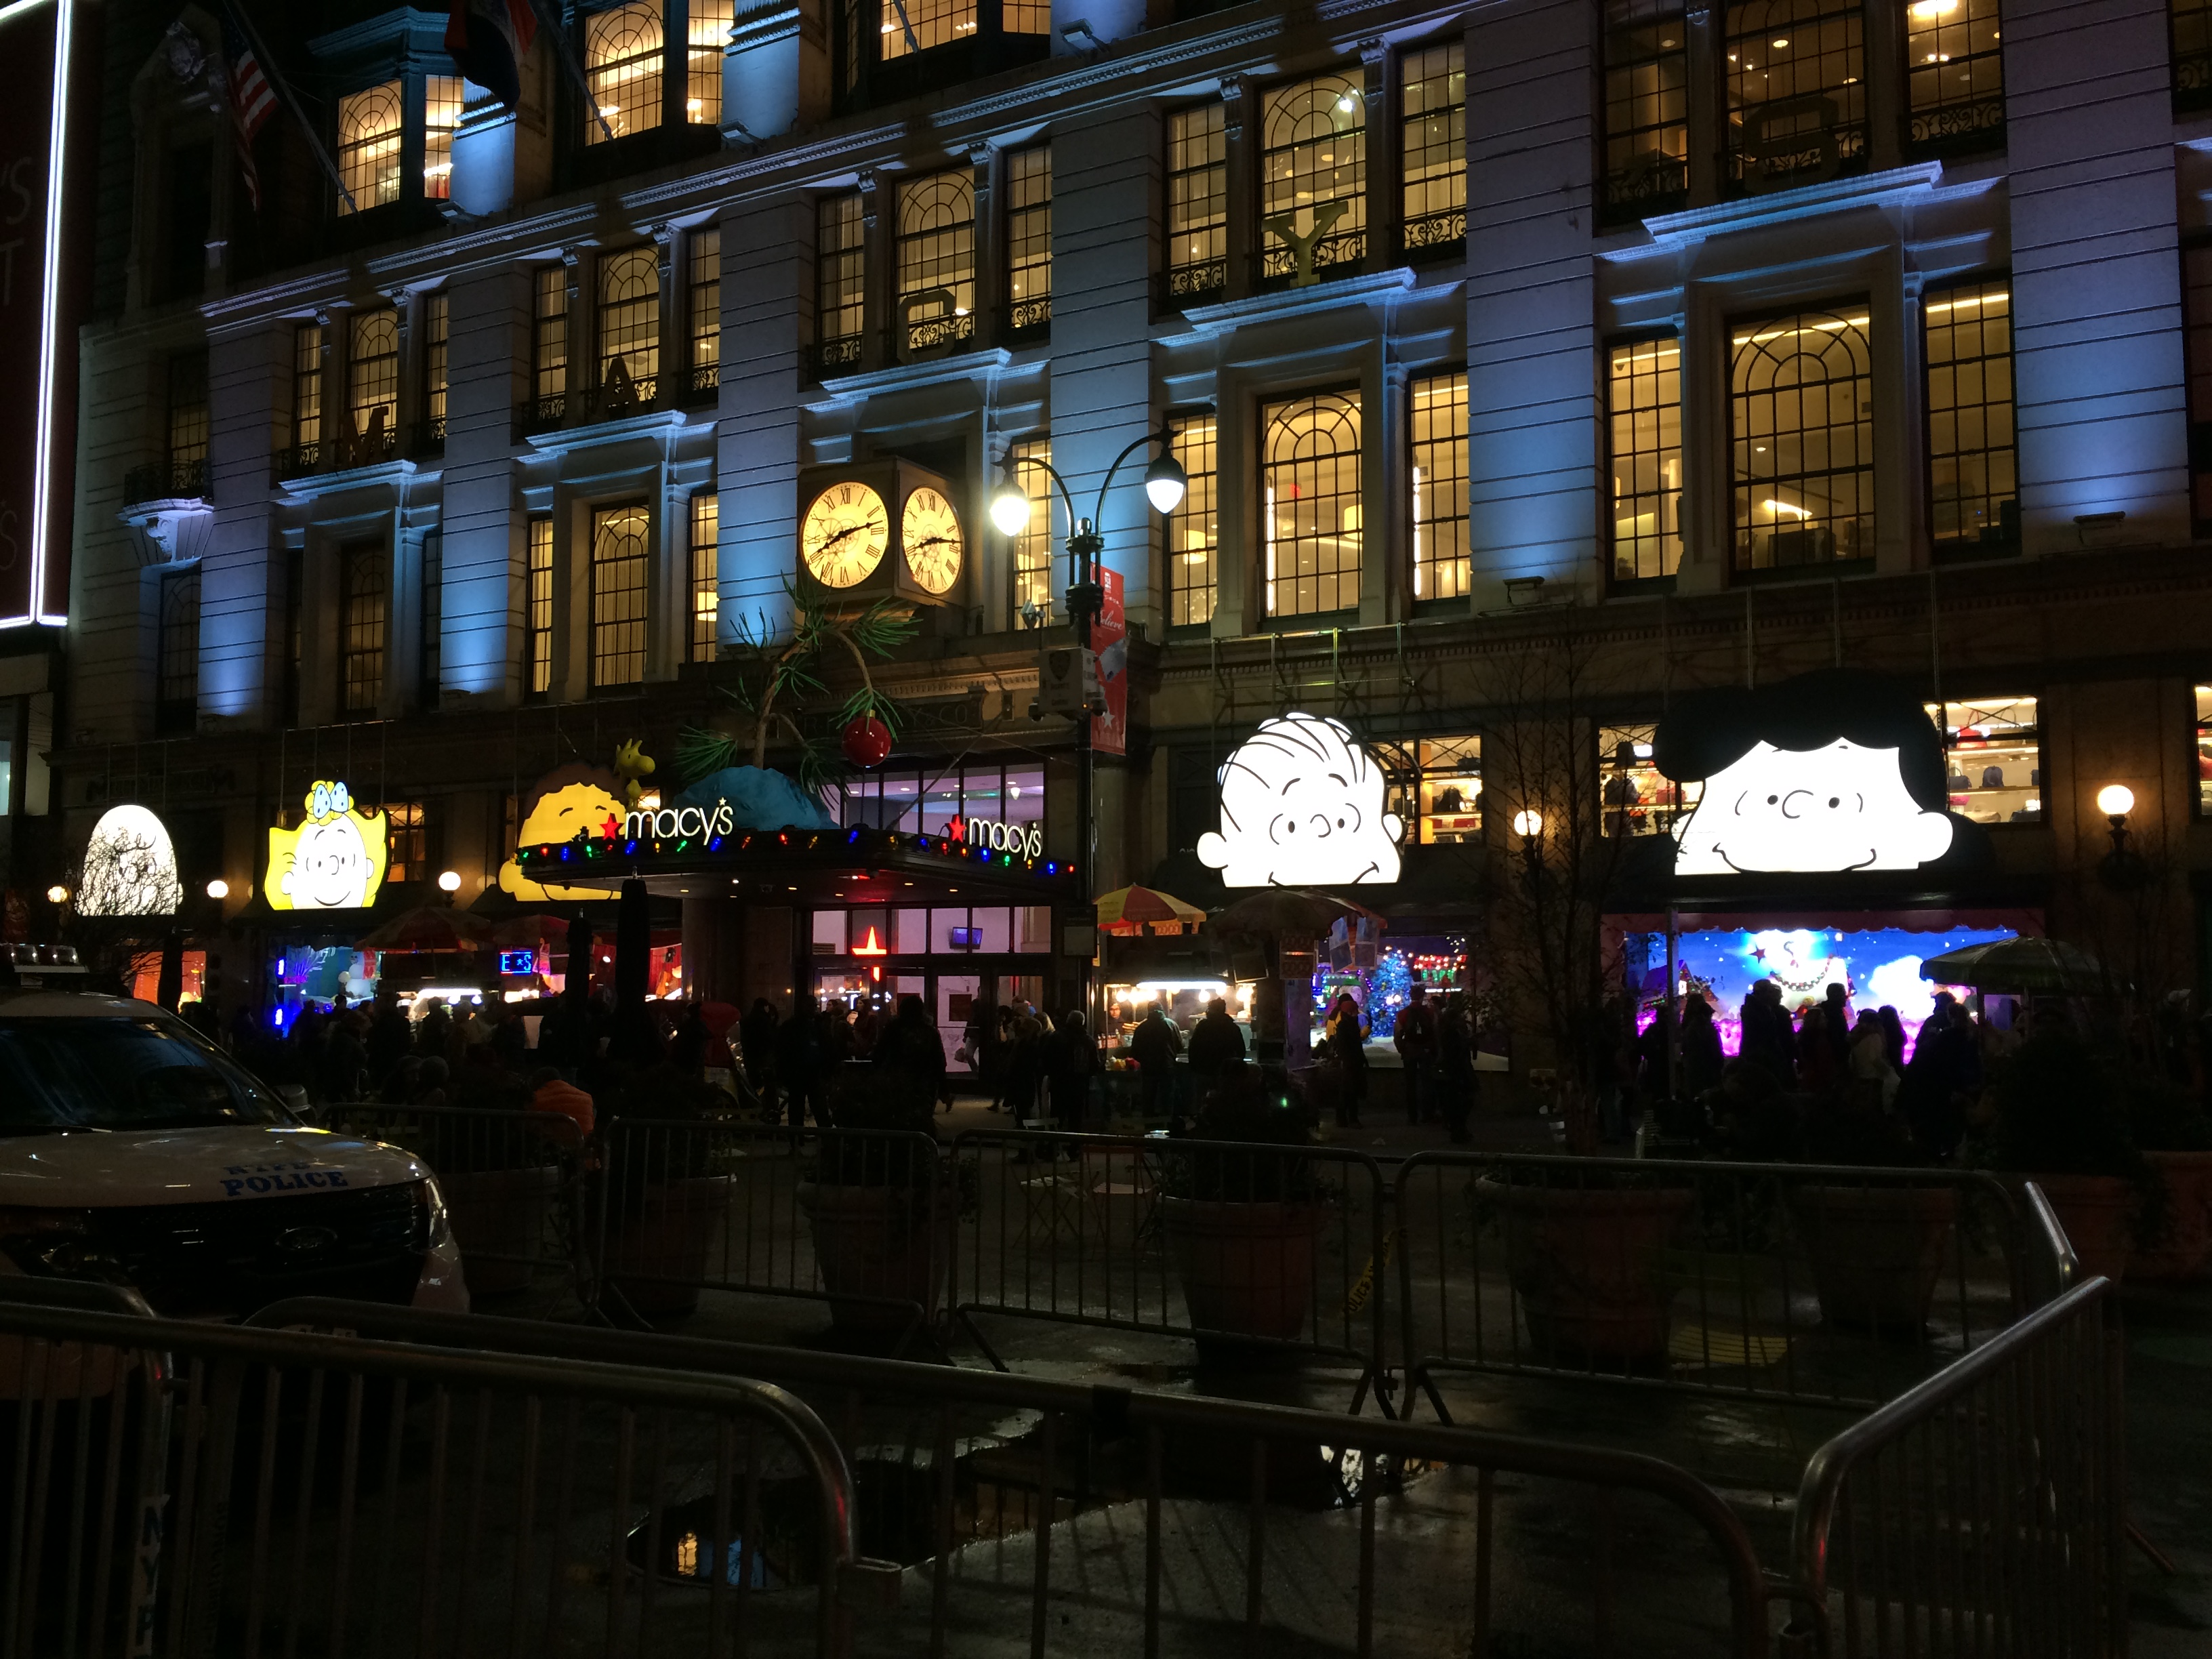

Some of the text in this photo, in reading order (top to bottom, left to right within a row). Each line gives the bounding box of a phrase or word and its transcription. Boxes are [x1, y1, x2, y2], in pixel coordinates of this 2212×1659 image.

[337, 406, 396, 470] M
[594, 356, 645, 421] A
[896, 289, 956, 365] C
[1261, 201, 1349, 287] Y
[220, 1171, 348, 1197] POLICE
